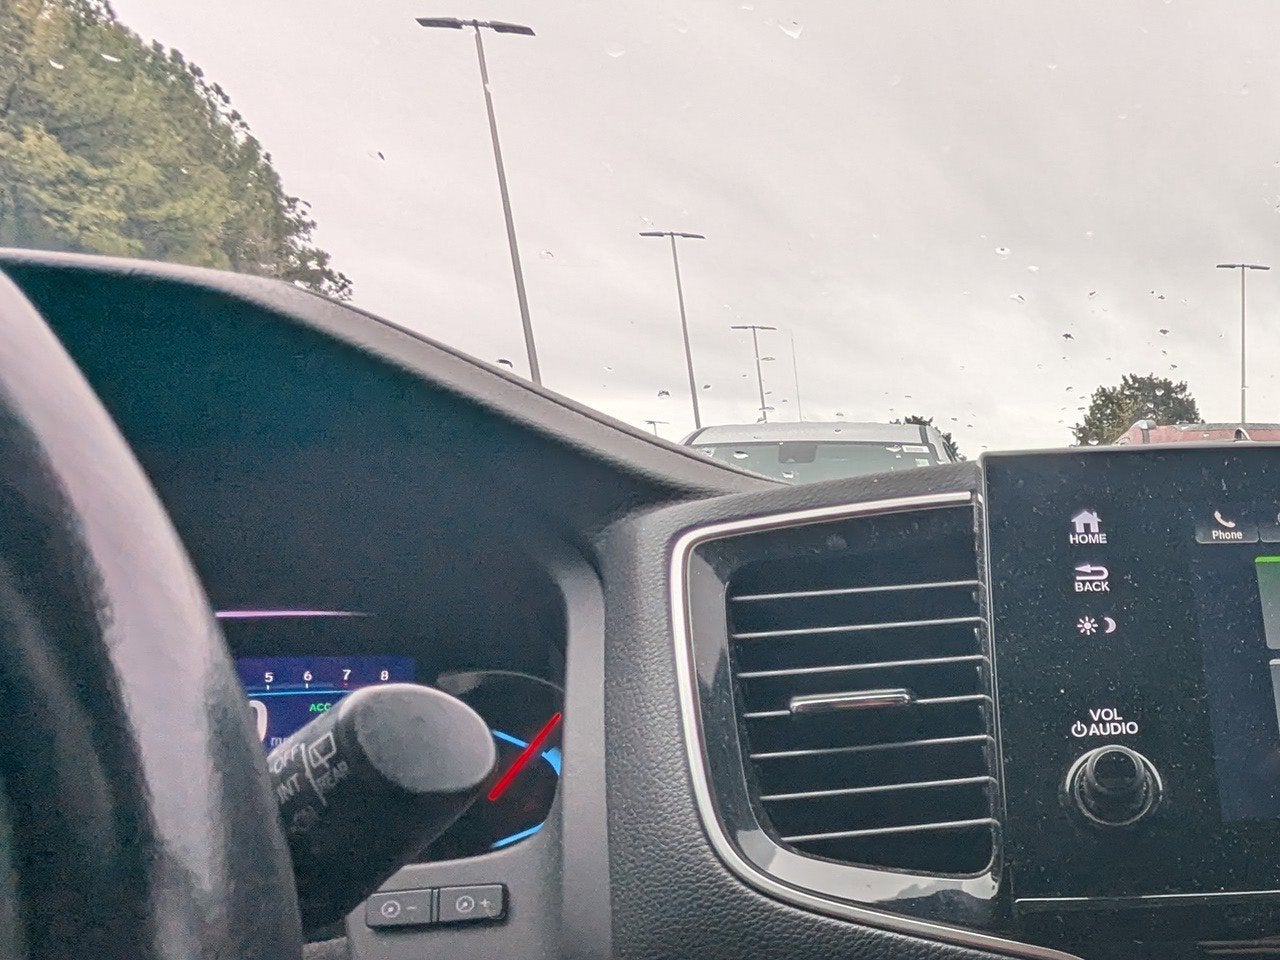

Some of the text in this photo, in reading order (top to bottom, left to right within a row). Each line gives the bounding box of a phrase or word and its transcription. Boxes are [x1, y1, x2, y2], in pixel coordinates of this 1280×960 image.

[1069, 533, 1108, 544] HOME
[1212, 530, 1243, 540] Phone
[1074, 581, 1110, 592] BACK
[264, 672, 274, 683] 5
[303, 671, 313, 682] 6
[343, 669, 352, 681] 7
[380, 670, 389, 681] 8
[1088, 708, 1123, 721] VOL
[1089, 721, 1139, 736] AUDIO
